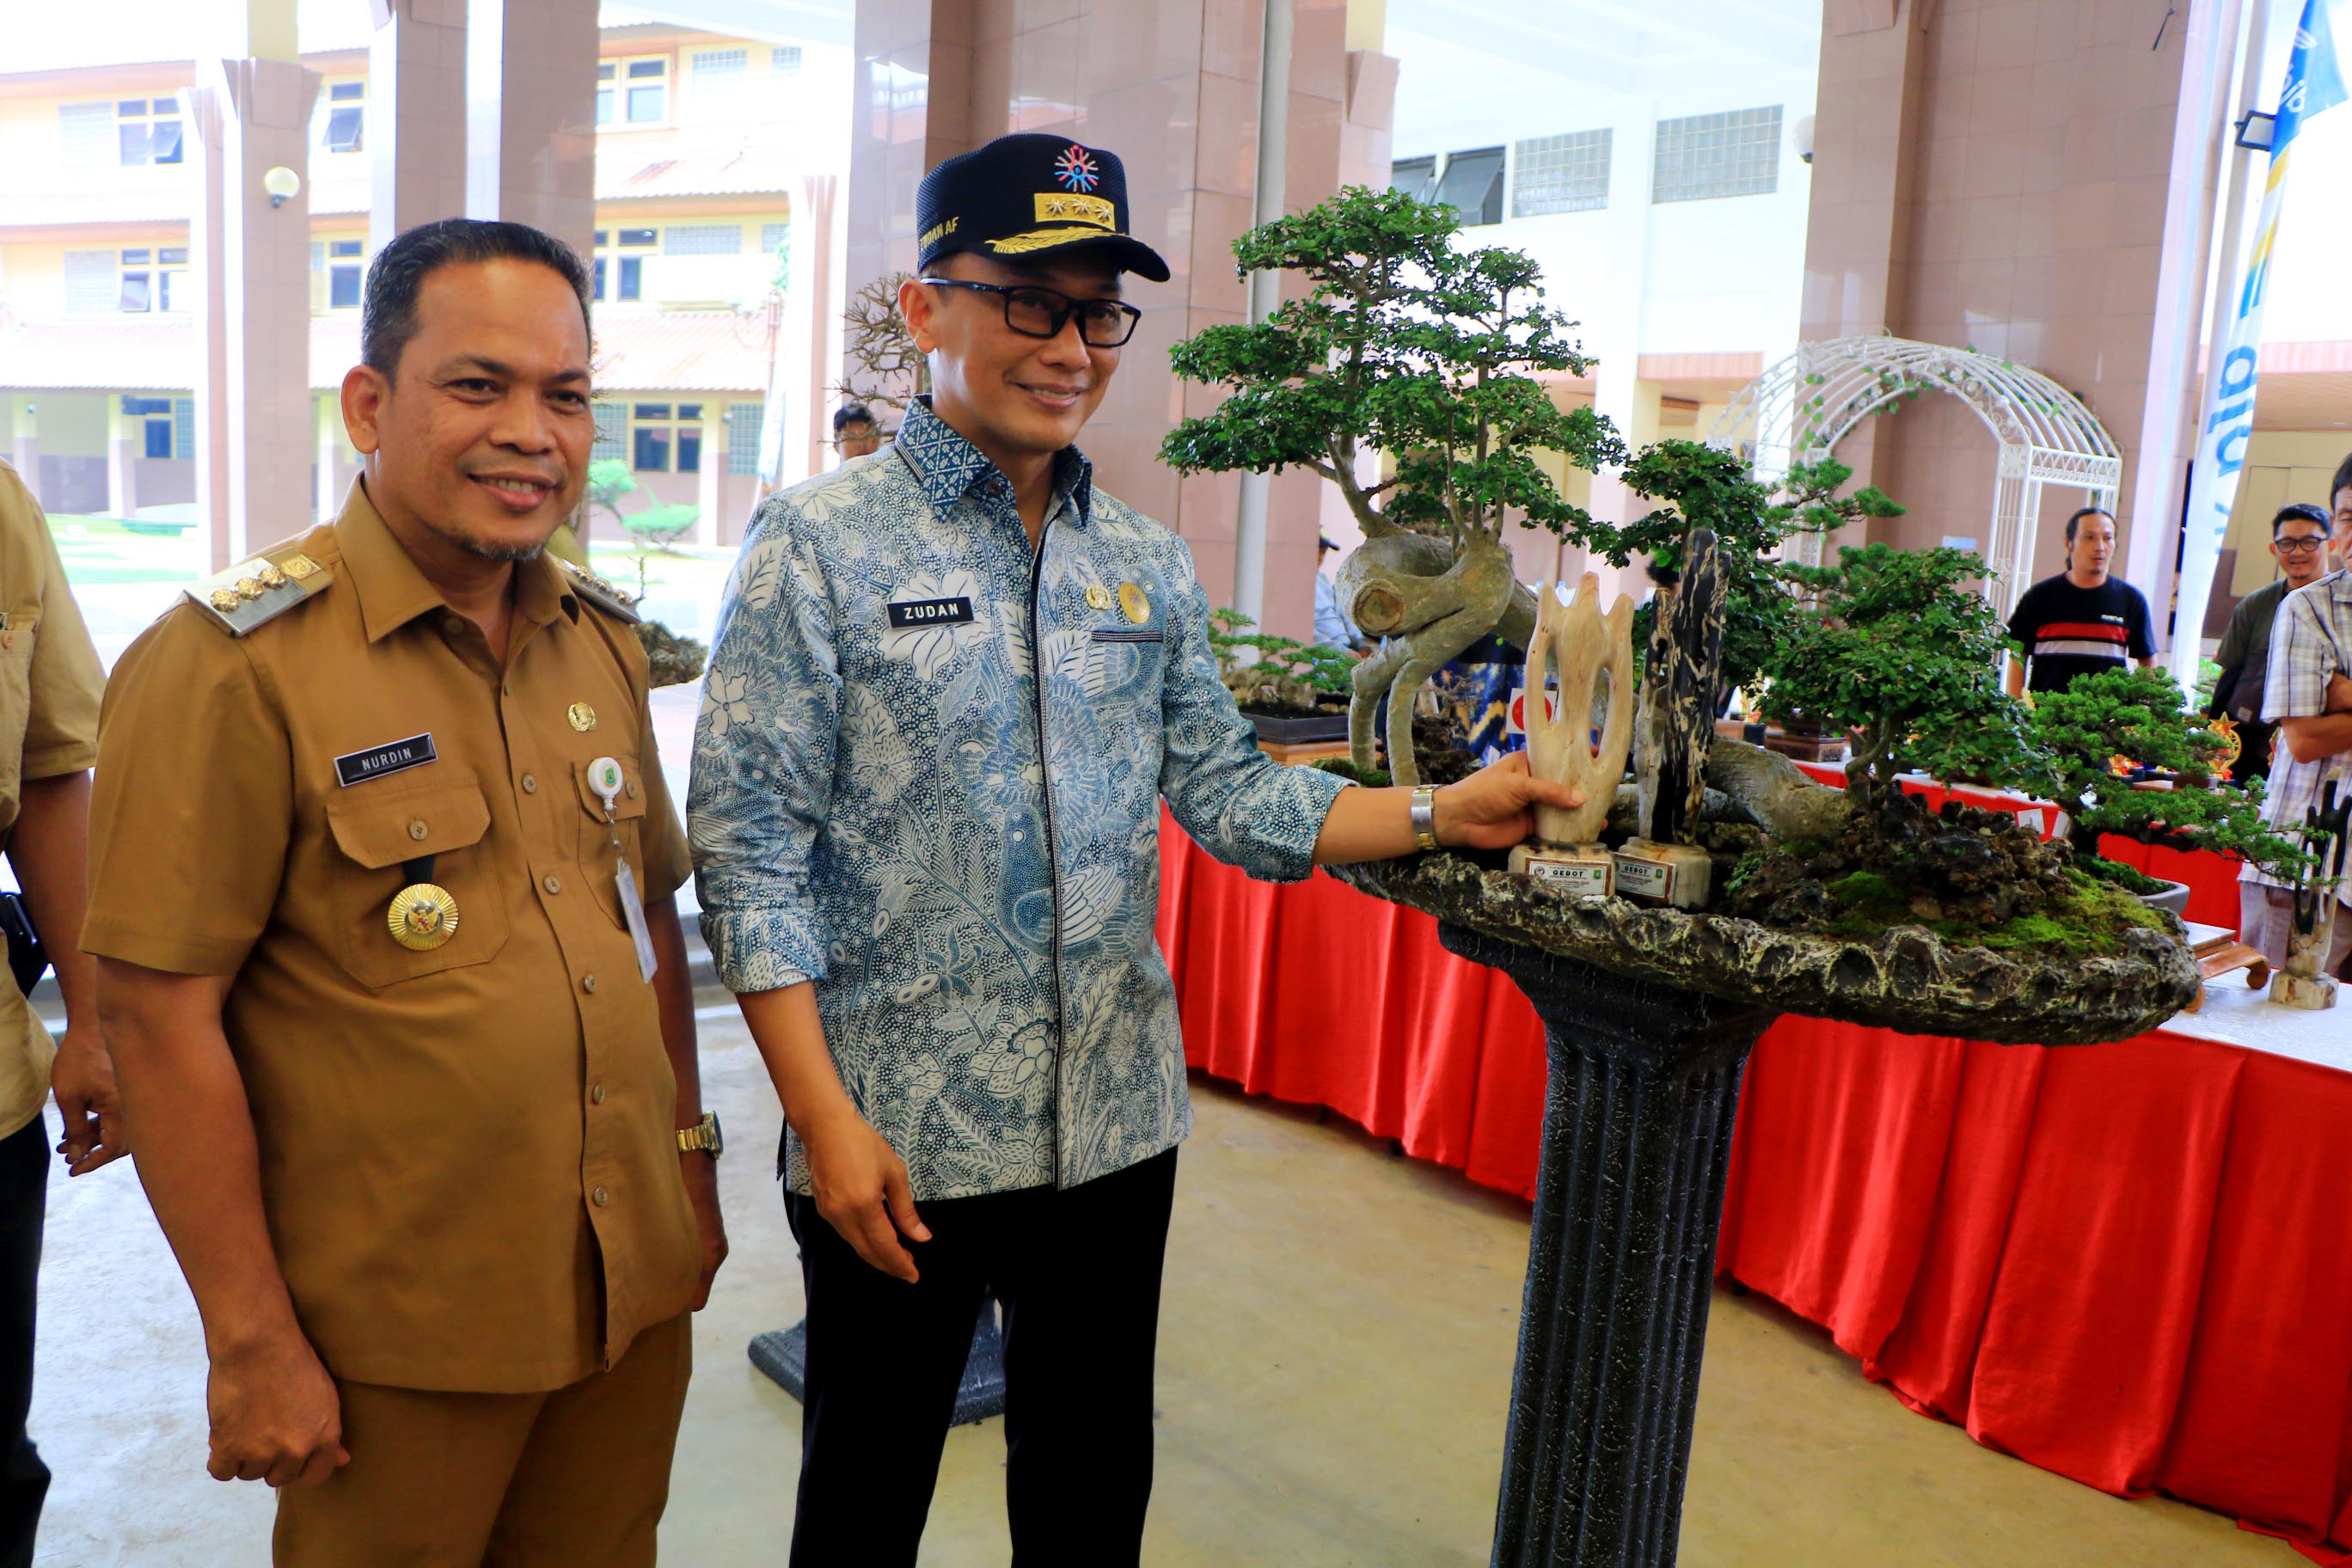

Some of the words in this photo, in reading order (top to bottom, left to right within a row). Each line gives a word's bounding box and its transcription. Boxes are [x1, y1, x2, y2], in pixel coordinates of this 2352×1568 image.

[945, 216, 959, 236] AF
[903, 603, 959, 620] ZUDAN
[361, 747, 412, 771] NURDIN
